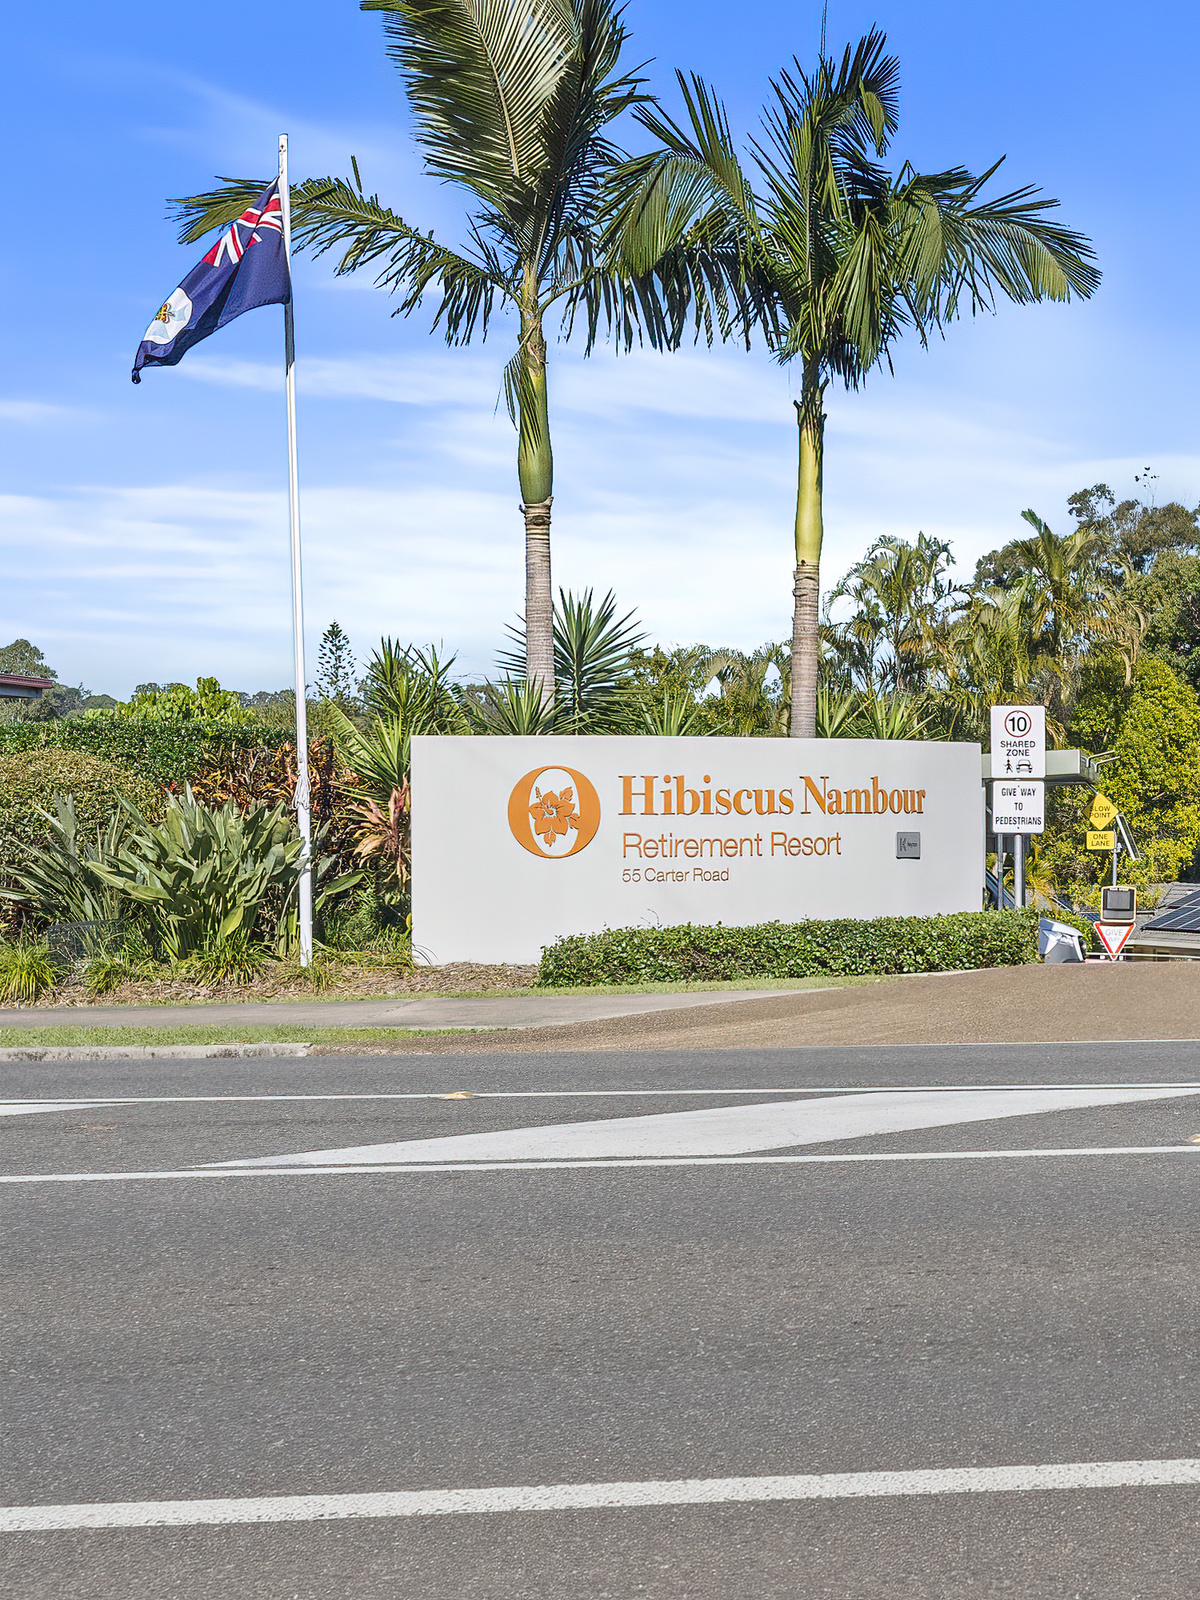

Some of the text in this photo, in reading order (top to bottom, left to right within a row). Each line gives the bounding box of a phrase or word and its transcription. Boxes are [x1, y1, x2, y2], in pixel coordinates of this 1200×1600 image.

[1008, 716, 1027, 732] 10
[1000, 740, 1036, 748] SHARED
[1005, 749, 1030, 757] ZONE
[618, 774, 926, 816] Hibiscus Nambour
[1001, 788, 1036, 797] GIVE WAY
[1014, 802, 1023, 811] TO
[995, 816, 1042, 826] PEDESTRIANS
[622, 831, 842, 858] Retirement Resort
[622, 867, 730, 883] 55 Carter Road
[1105, 929, 1124, 937] GIVE
